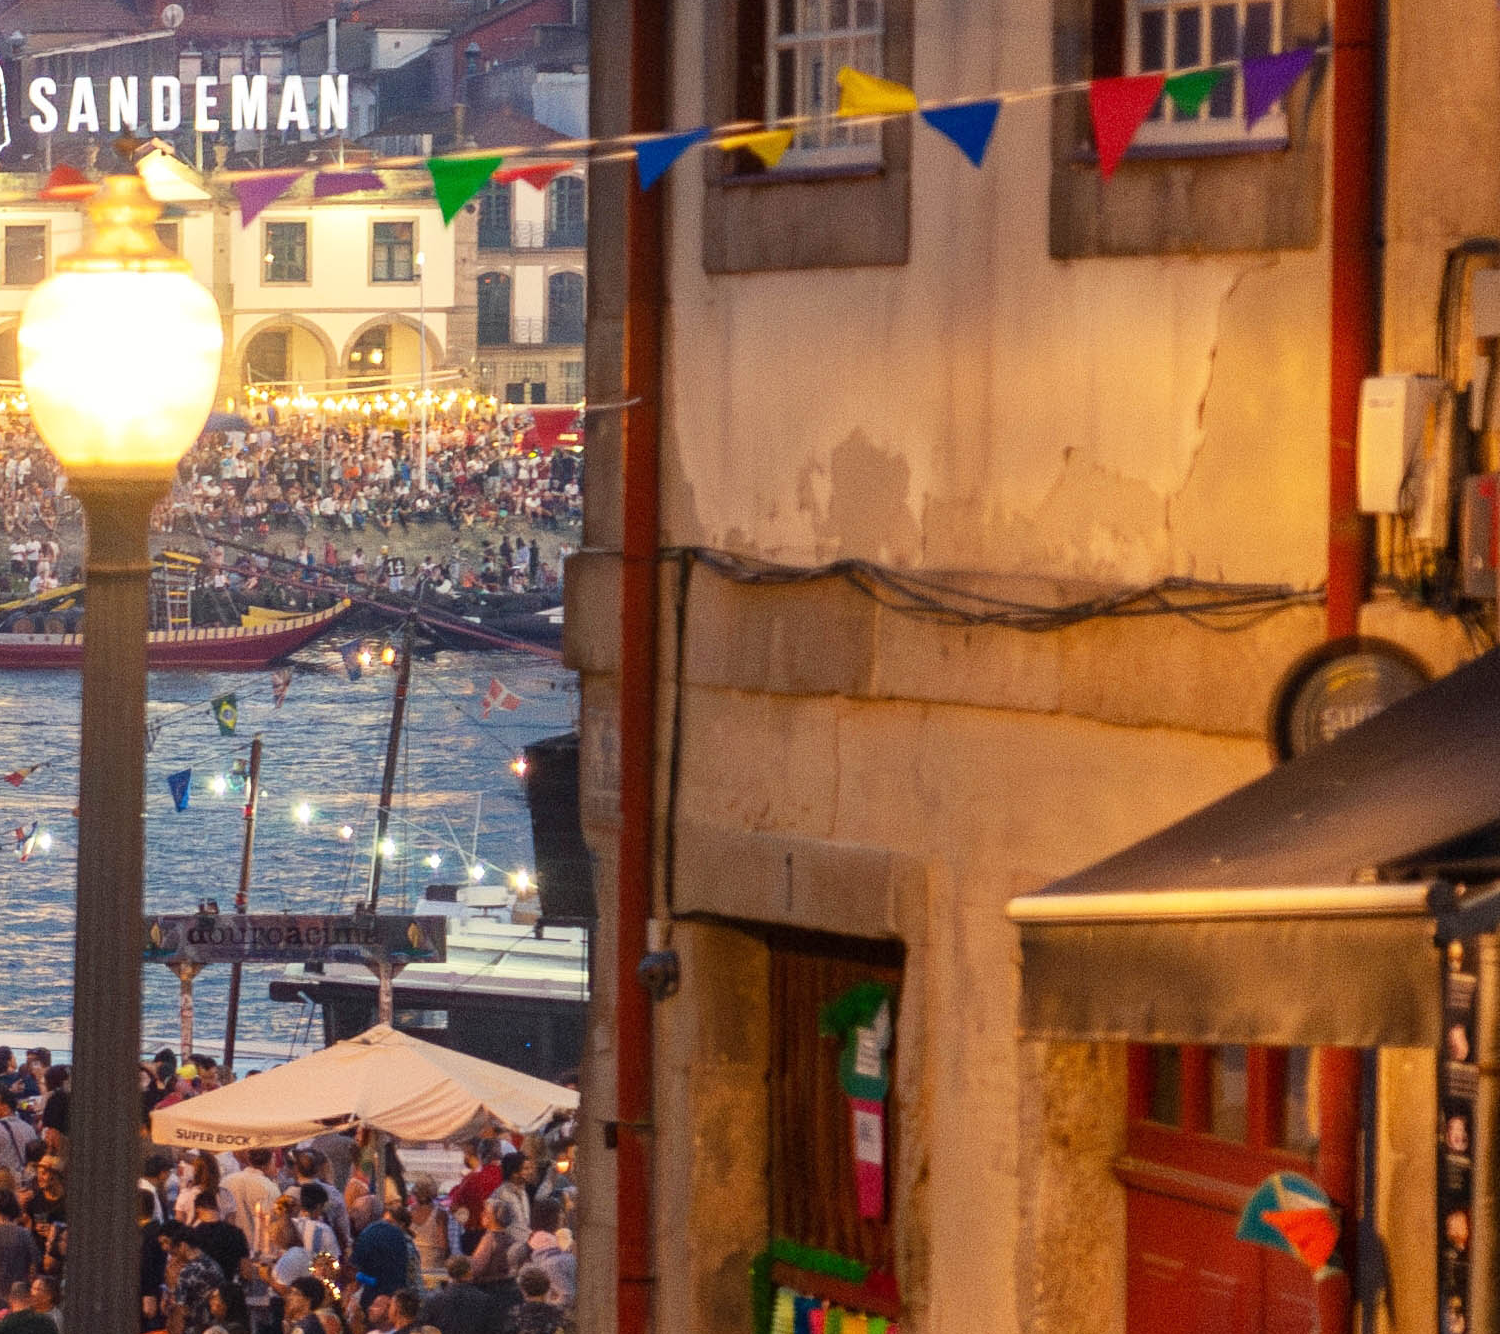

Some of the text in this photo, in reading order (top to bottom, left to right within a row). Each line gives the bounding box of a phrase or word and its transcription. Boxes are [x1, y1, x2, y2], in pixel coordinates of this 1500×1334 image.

[29, 73, 349, 135] SANDEMAN
[175, 1128, 250, 1146] SUPER BOCK
